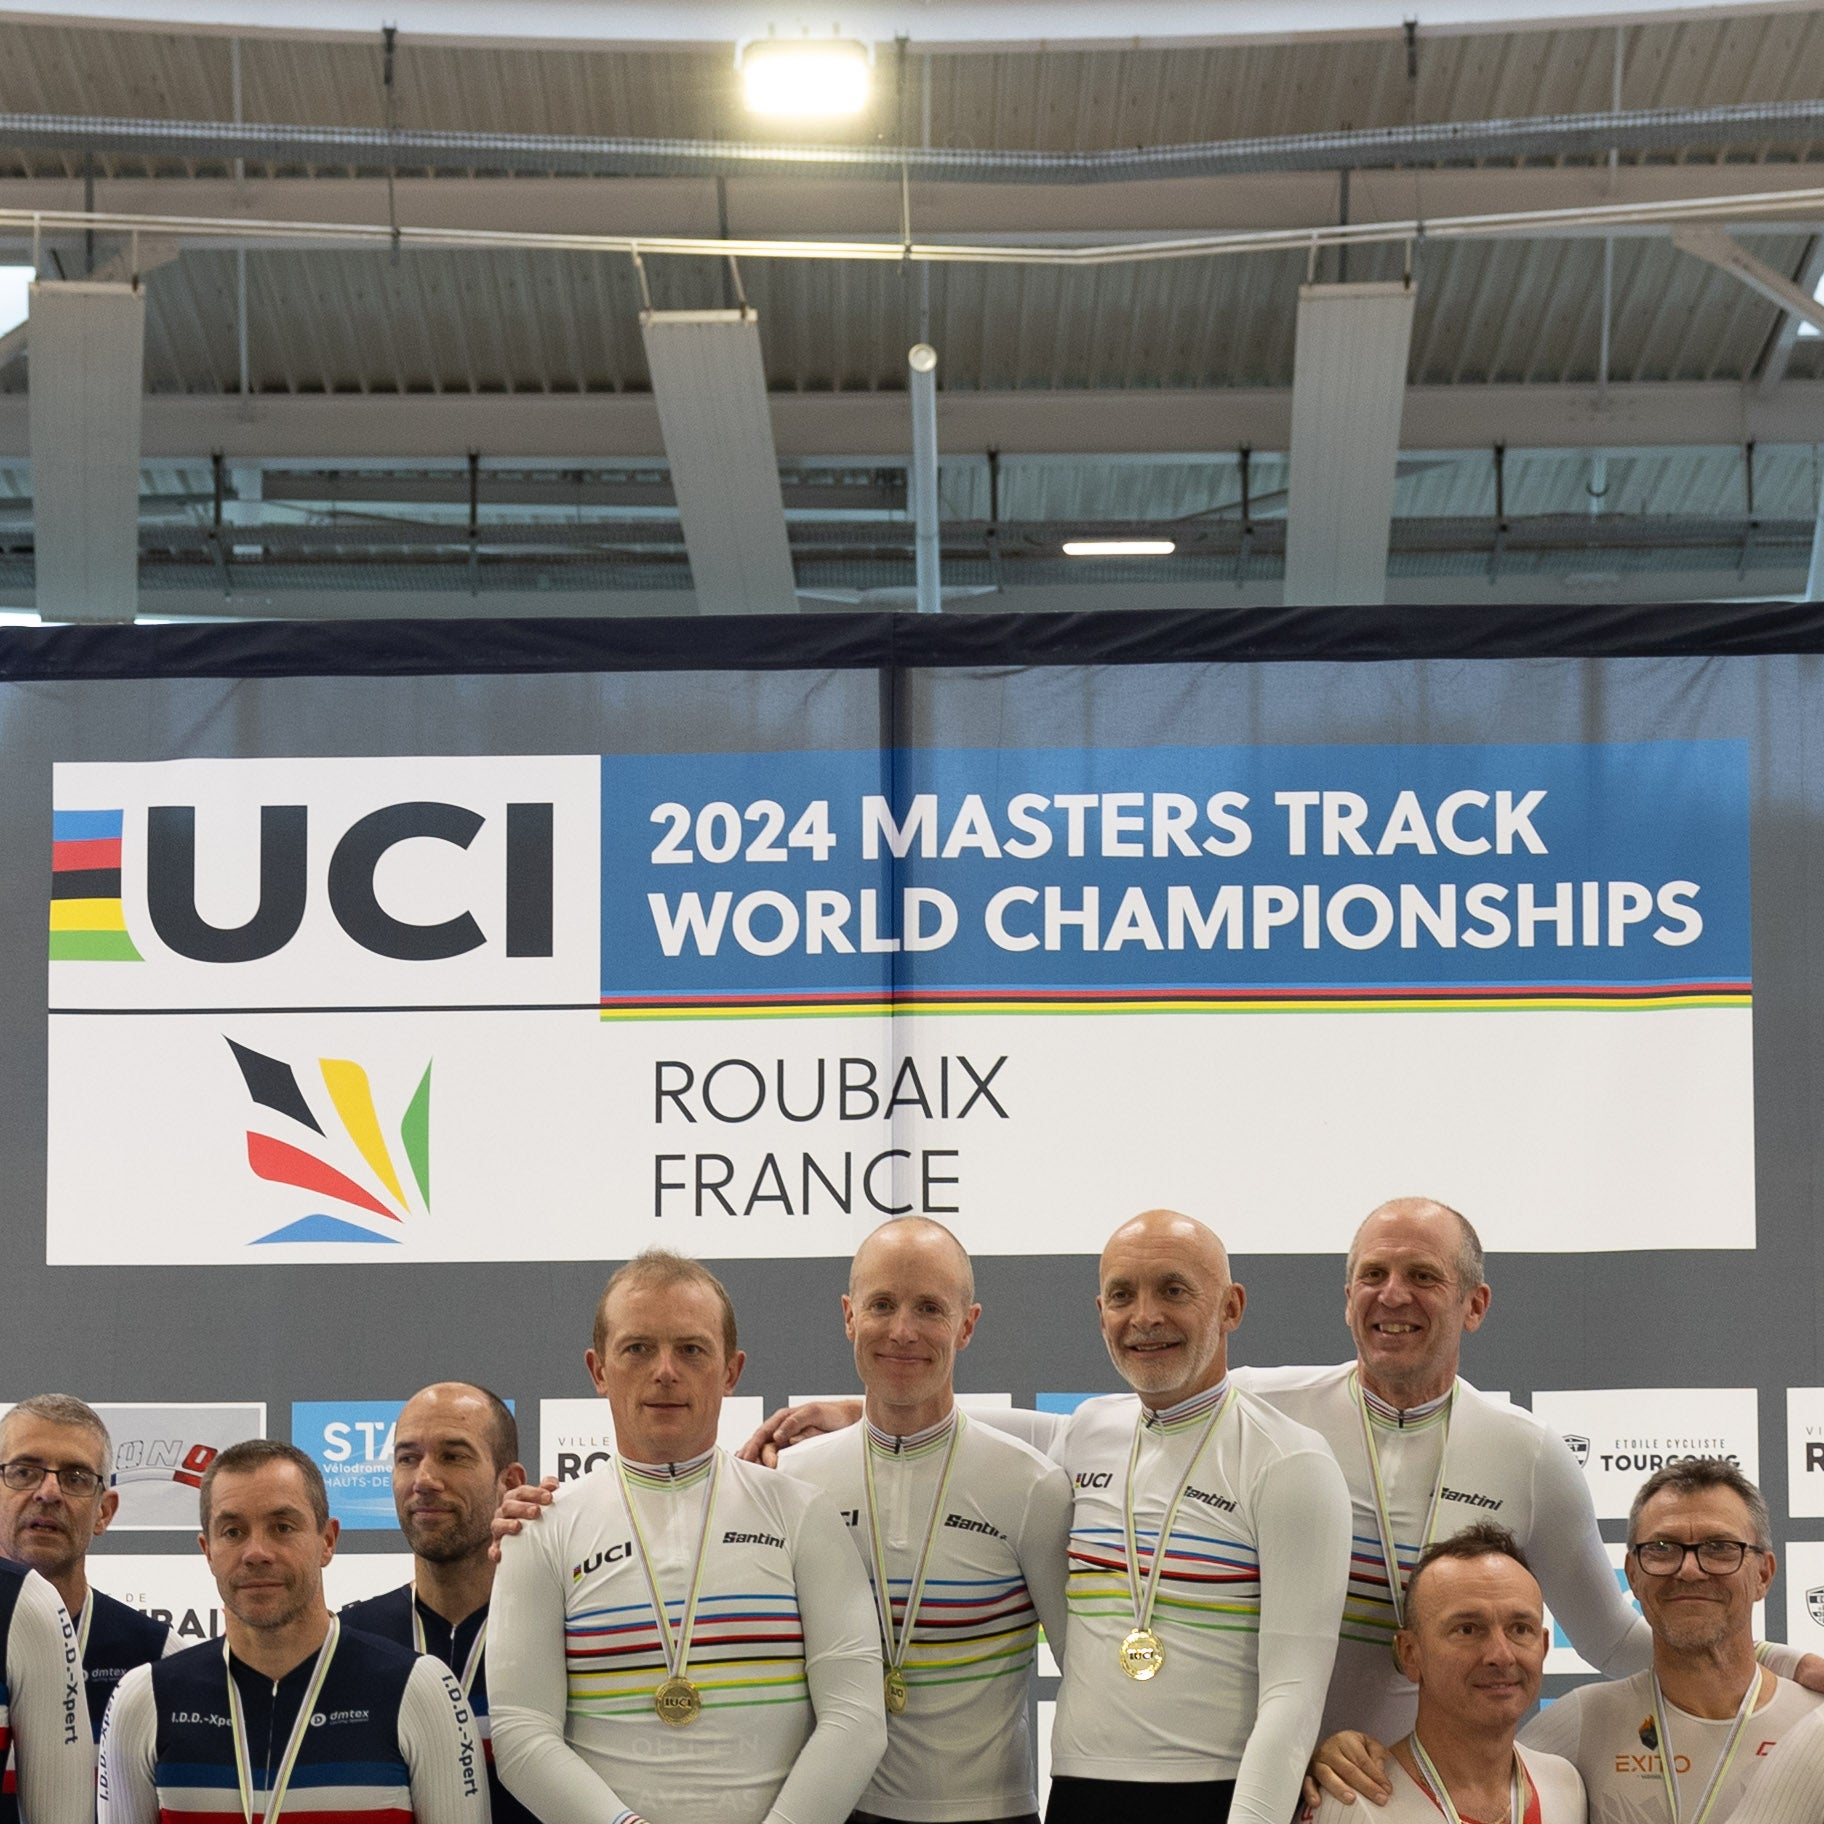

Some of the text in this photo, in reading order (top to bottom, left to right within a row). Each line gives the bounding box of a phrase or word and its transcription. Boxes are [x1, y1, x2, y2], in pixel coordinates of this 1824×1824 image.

[650, 789, 1549, 864] 2024 MASTERS TRACK
[147, 801, 554, 963] UCI
[648, 880, 1704, 957] WORLD CHAMPIONSHIPS
[655, 1055, 1010, 1125] ROUBAIX
[655, 1148, 961, 1217] FRANCE
[558, 1436, 611, 1447] VILLE
[1615, 1438, 1725, 1449] ETOILE CYCLISTE
[583, 1541, 632, 1574] UCI
[723, 1531, 786, 1549] Santini
[330, 1709, 370, 1721] dmtex
